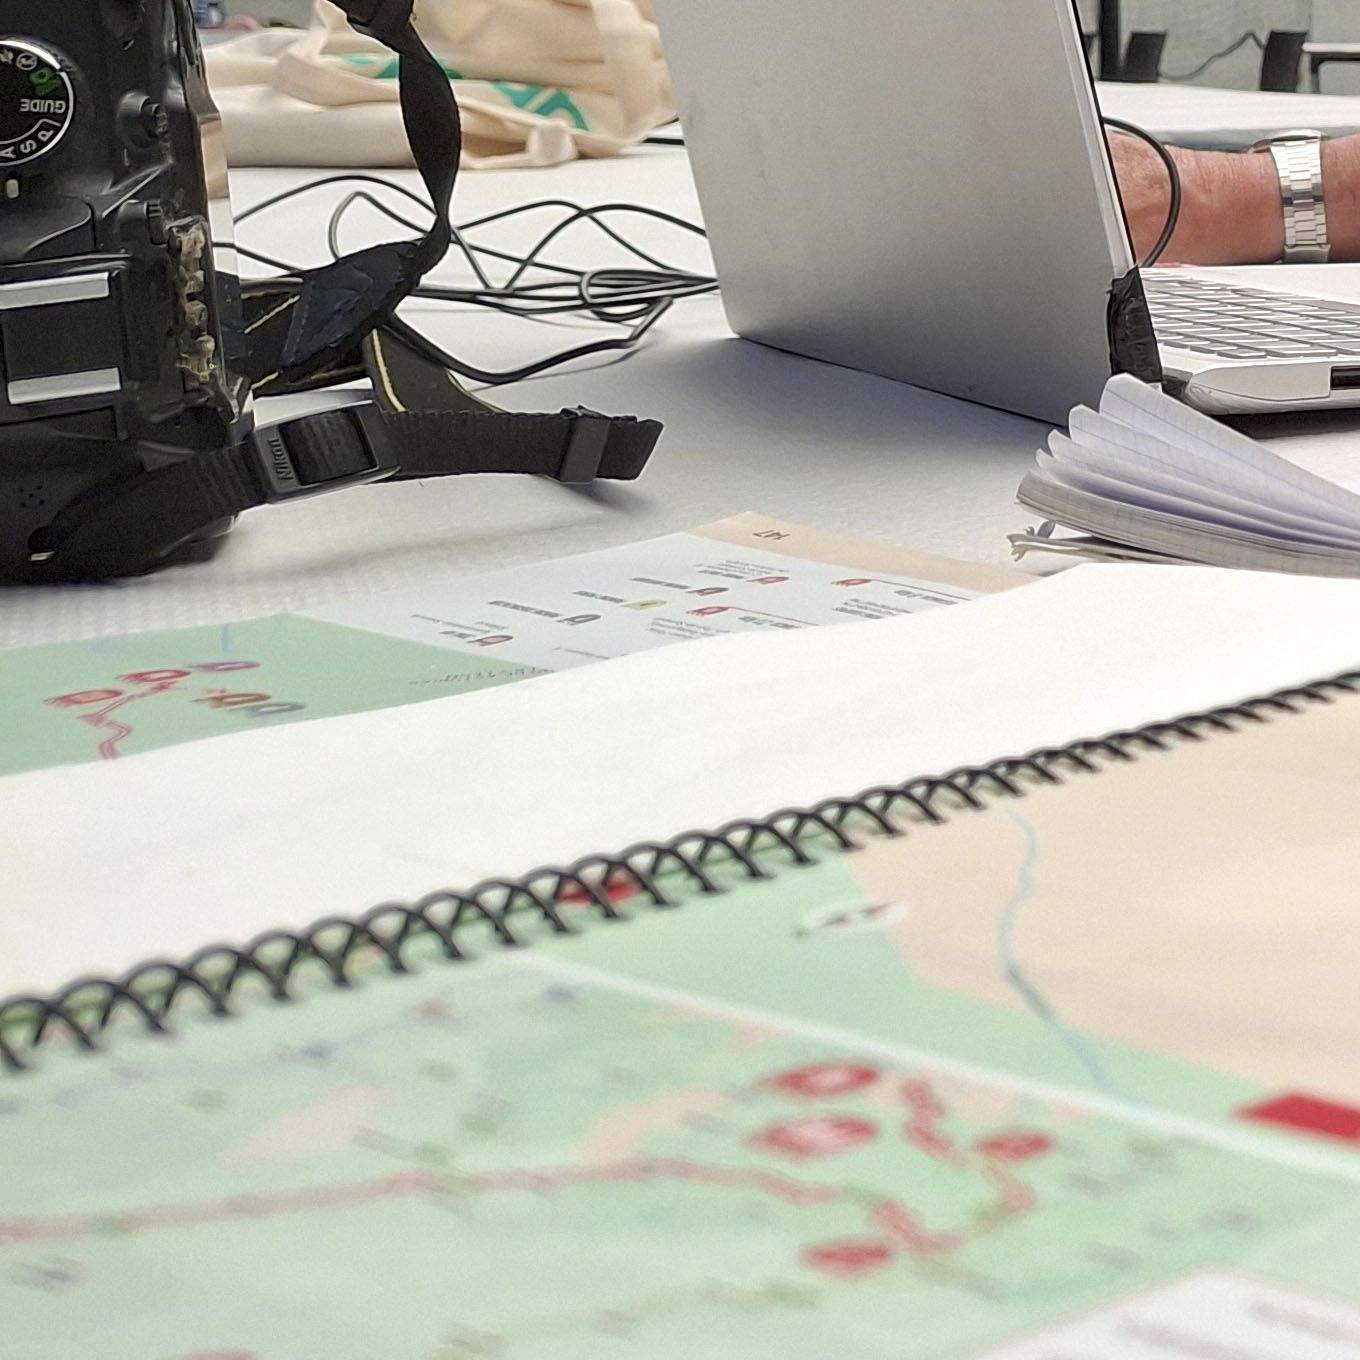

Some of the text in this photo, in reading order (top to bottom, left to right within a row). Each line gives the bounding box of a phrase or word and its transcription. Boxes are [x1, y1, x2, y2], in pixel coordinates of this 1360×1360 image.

[20, 98, 67, 113] GUIDE
[37, 129, 54, 142] P
[20, 139, 37, 154] S
[267, 439, 296, 481] Nikon
